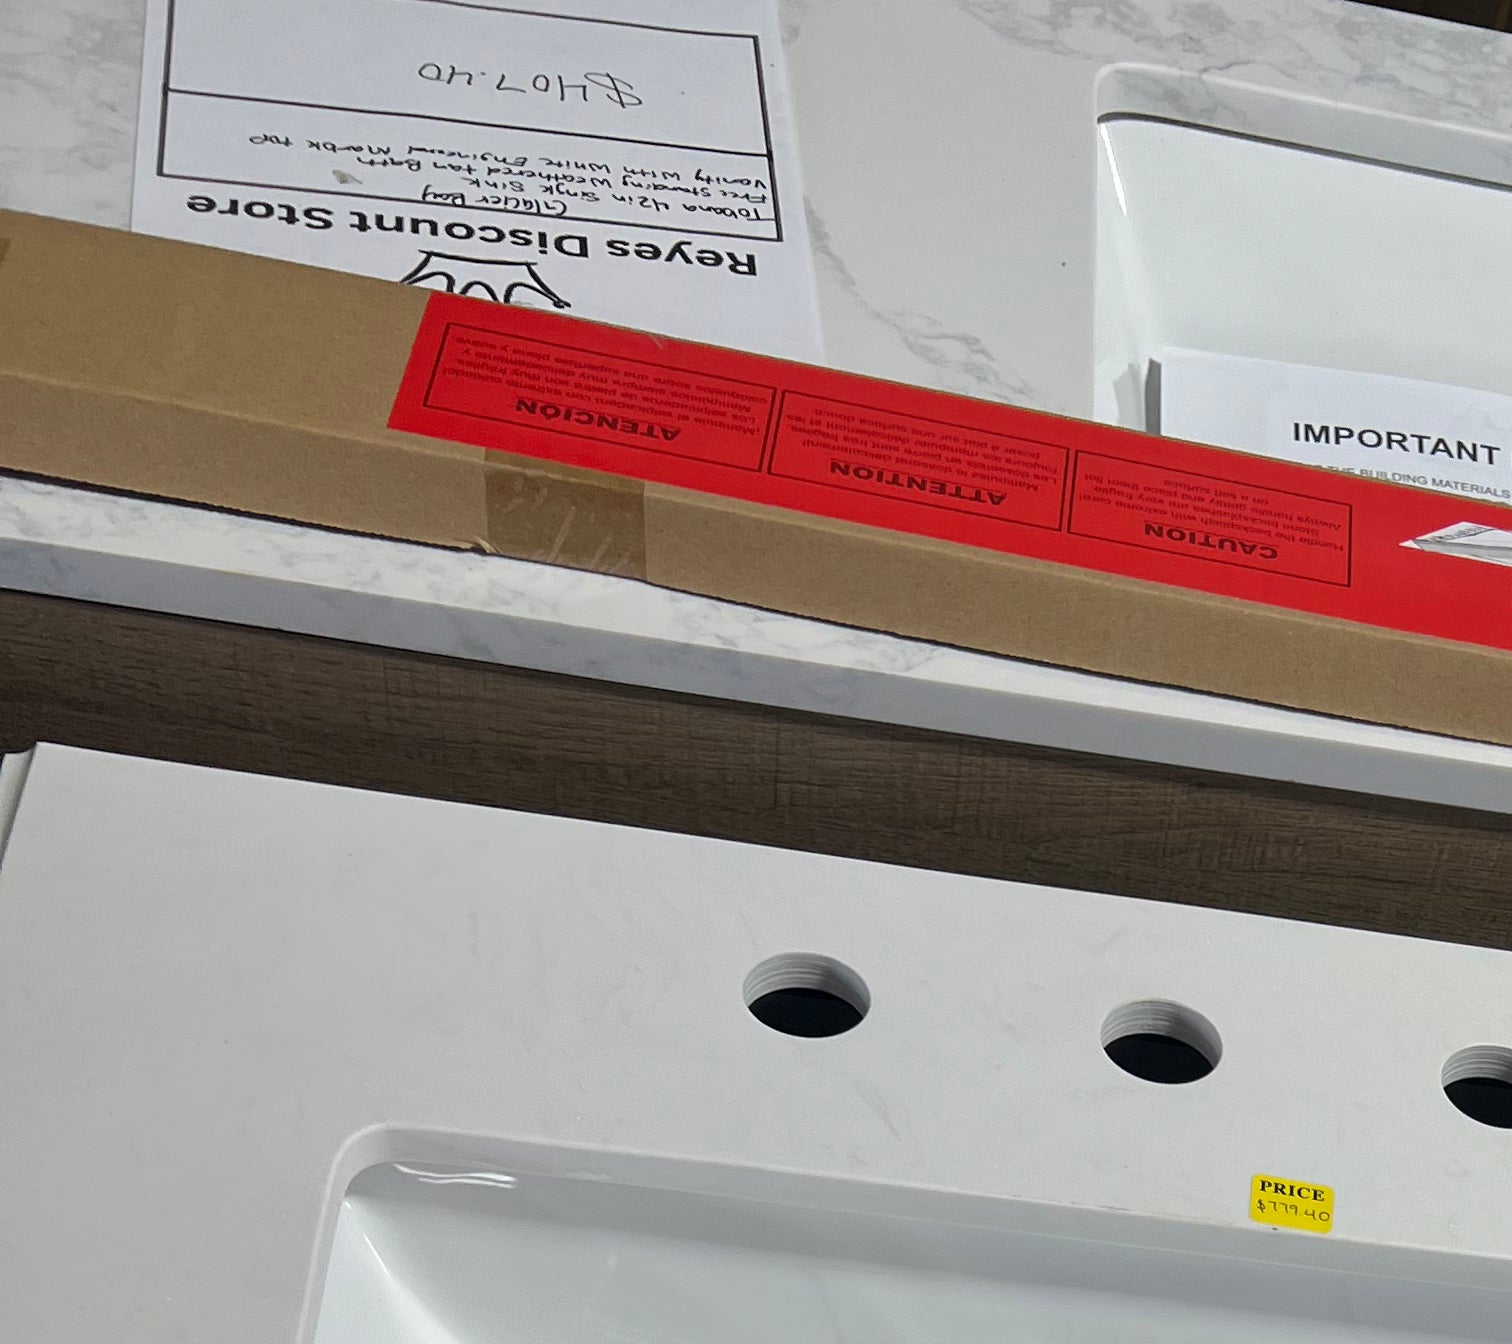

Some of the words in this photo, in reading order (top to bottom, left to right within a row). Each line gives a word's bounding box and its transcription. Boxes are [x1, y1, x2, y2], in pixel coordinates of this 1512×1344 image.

[417, 62, 643, 109] $407.40
[185, 194, 334, 231] Store
[419, 182, 466, 205] Bay
[473, 192, 567, 217] Glacier
[680, 202, 775, 223] Tobana
[348, 210, 590, 259] Discount
[605, 238, 758, 277] Reyes
[513, 397, 680, 443] ATENCIÓN
[1291, 421, 1501, 466] IMPORTANT
[827, 459, 1006, 507] ATTENTION
[1358, 467, 1429, 486] BUILDING
[1429, 476, 1512, 500] MATERIALS
[1141, 521, 1279, 561] CAUTION
[1259, 1180, 1325, 1202] PRICE
